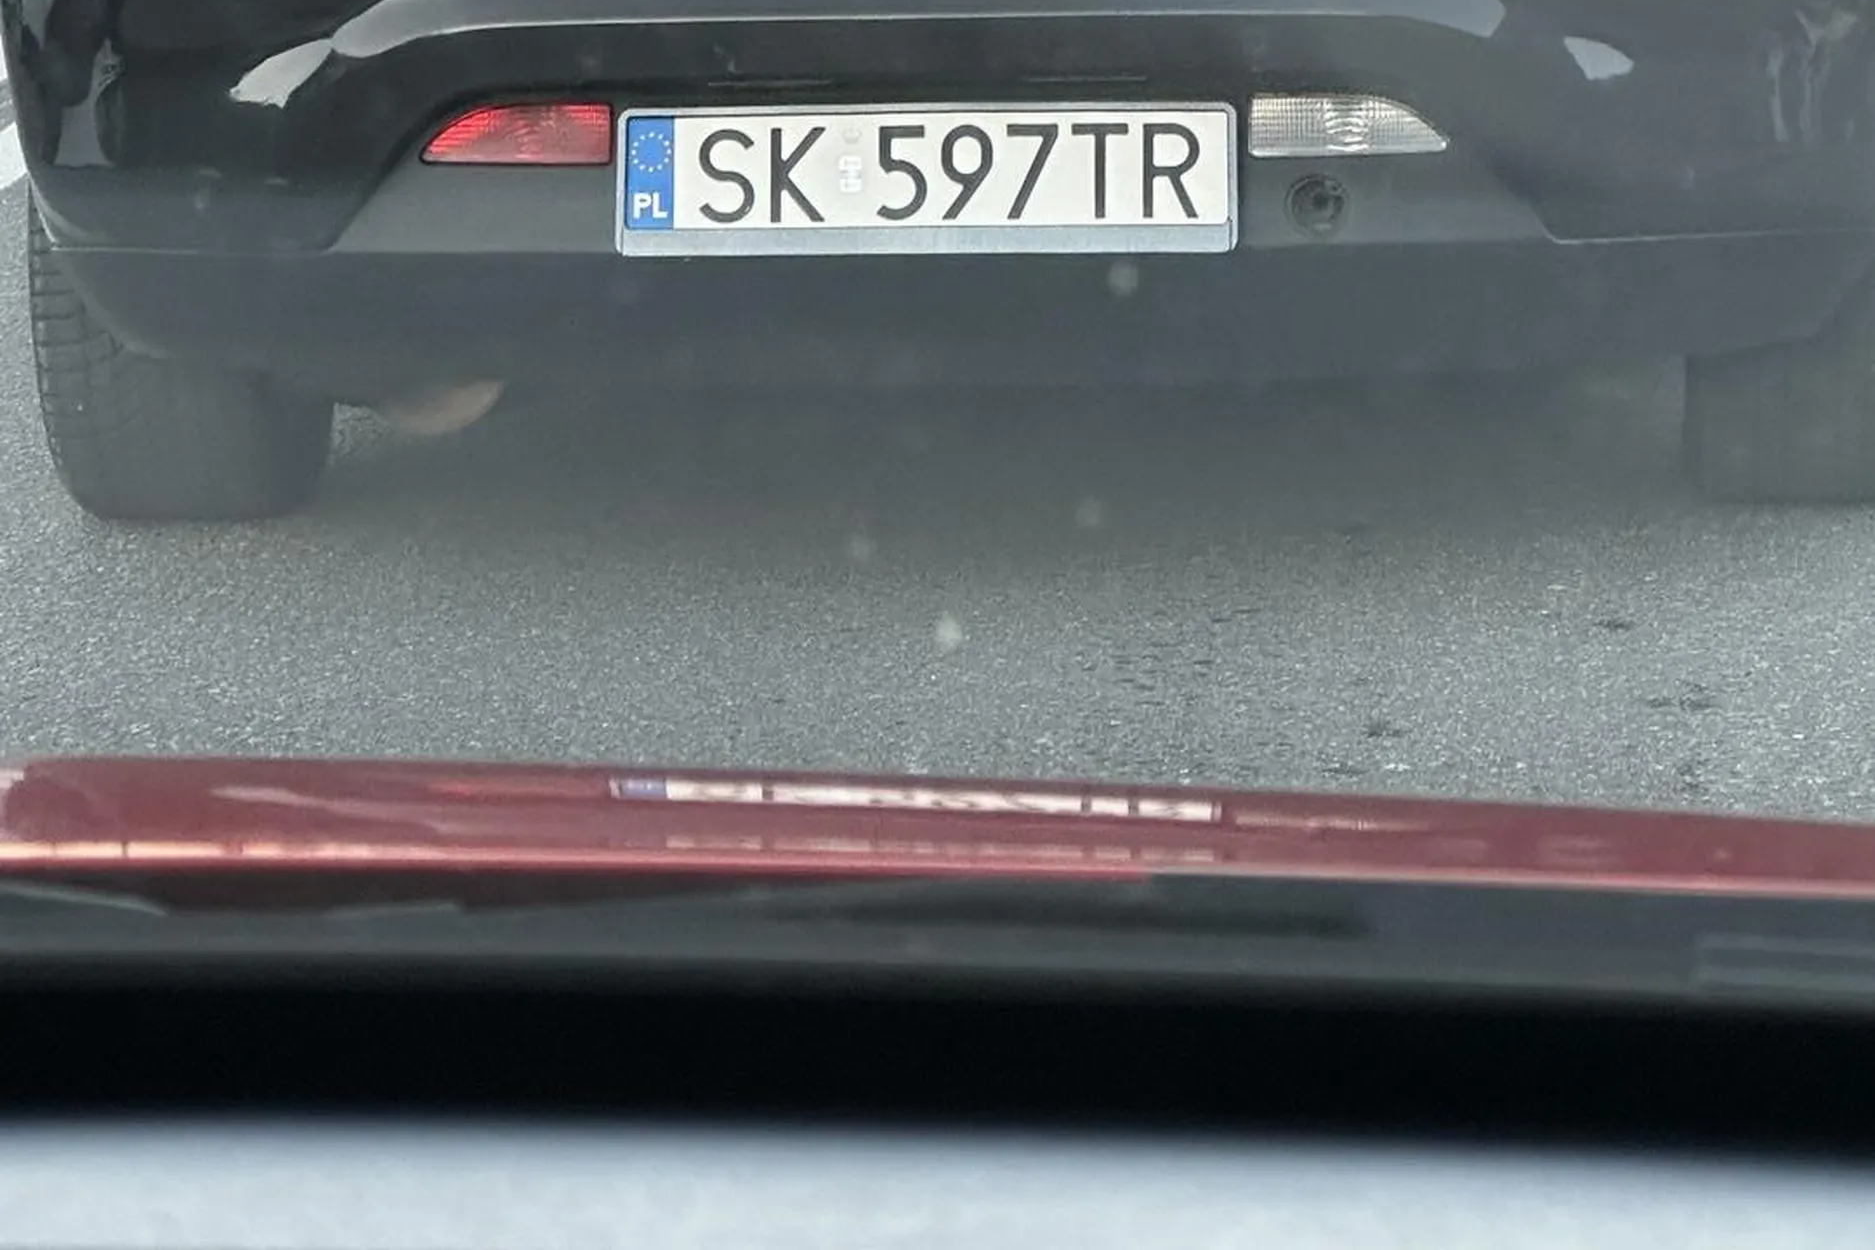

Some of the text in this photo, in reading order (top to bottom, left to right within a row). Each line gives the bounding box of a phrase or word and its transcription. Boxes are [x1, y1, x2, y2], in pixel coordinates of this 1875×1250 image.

[699, 123, 1200, 223] SK 597TR
[633, 192, 668, 219] PL
